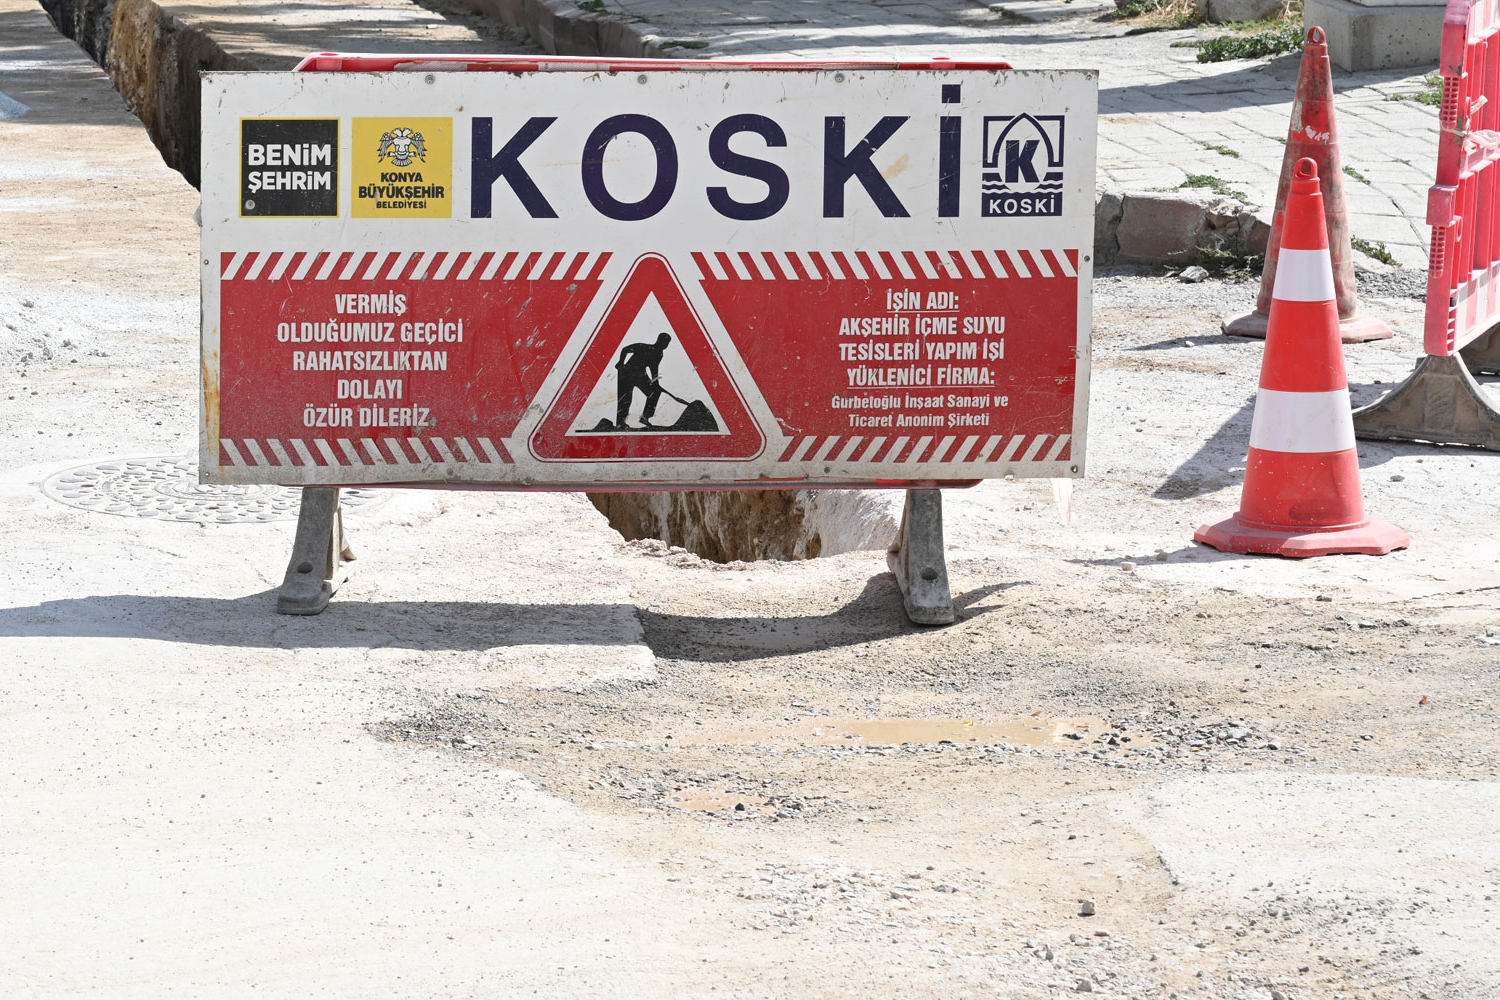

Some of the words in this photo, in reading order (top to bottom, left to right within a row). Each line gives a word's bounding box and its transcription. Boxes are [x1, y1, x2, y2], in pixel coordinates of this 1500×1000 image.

[469, 83, 962, 222] KOSKİ
[1004, 139, 1041, 183] K
[380, 172, 424, 183] KONYA
[358, 183, 445, 200] BÜYÜKŞEHİR
[376, 199, 427, 209] BELEDİYESİ
[989, 194, 1055, 214] KOSKİ
[334, 289, 407, 317] VERMİŞ
[886, 288, 921, 312] İŞİN
[926, 291, 959, 310] ADI:
[277, 318, 395, 343] OLDUĞUMUZ
[400, 318, 464, 345] GEÇİCİ
[838, 313, 910, 337] AKŞEHİR
[915, 313, 958, 337] İÇME
[962, 316, 1006, 335] SUYU
[293, 350, 448, 371] RAHATSIZLIKTAN
[838, 338, 920, 361] TESİSLERİ
[925, 341, 977, 360] YAPIM
[982, 338, 1005, 361] İŞİ
[846, 364, 932, 386] YÜKLENİCİ
[937, 363, 996, 385] FİRMA:
[337, 379, 403, 399] DOLAYI
[905, 392, 945, 410] İnşaat
[947, 393, 990, 410] Sanayi
[993, 395, 1009, 407] ve
[303, 403, 353, 427] ÖZÜR
[359, 403, 430, 427] DİLERİZ
[848, 413, 894, 428] Ticaret
[896, 413, 945, 427] Anonim
[947, 412, 990, 428] Şirketi
